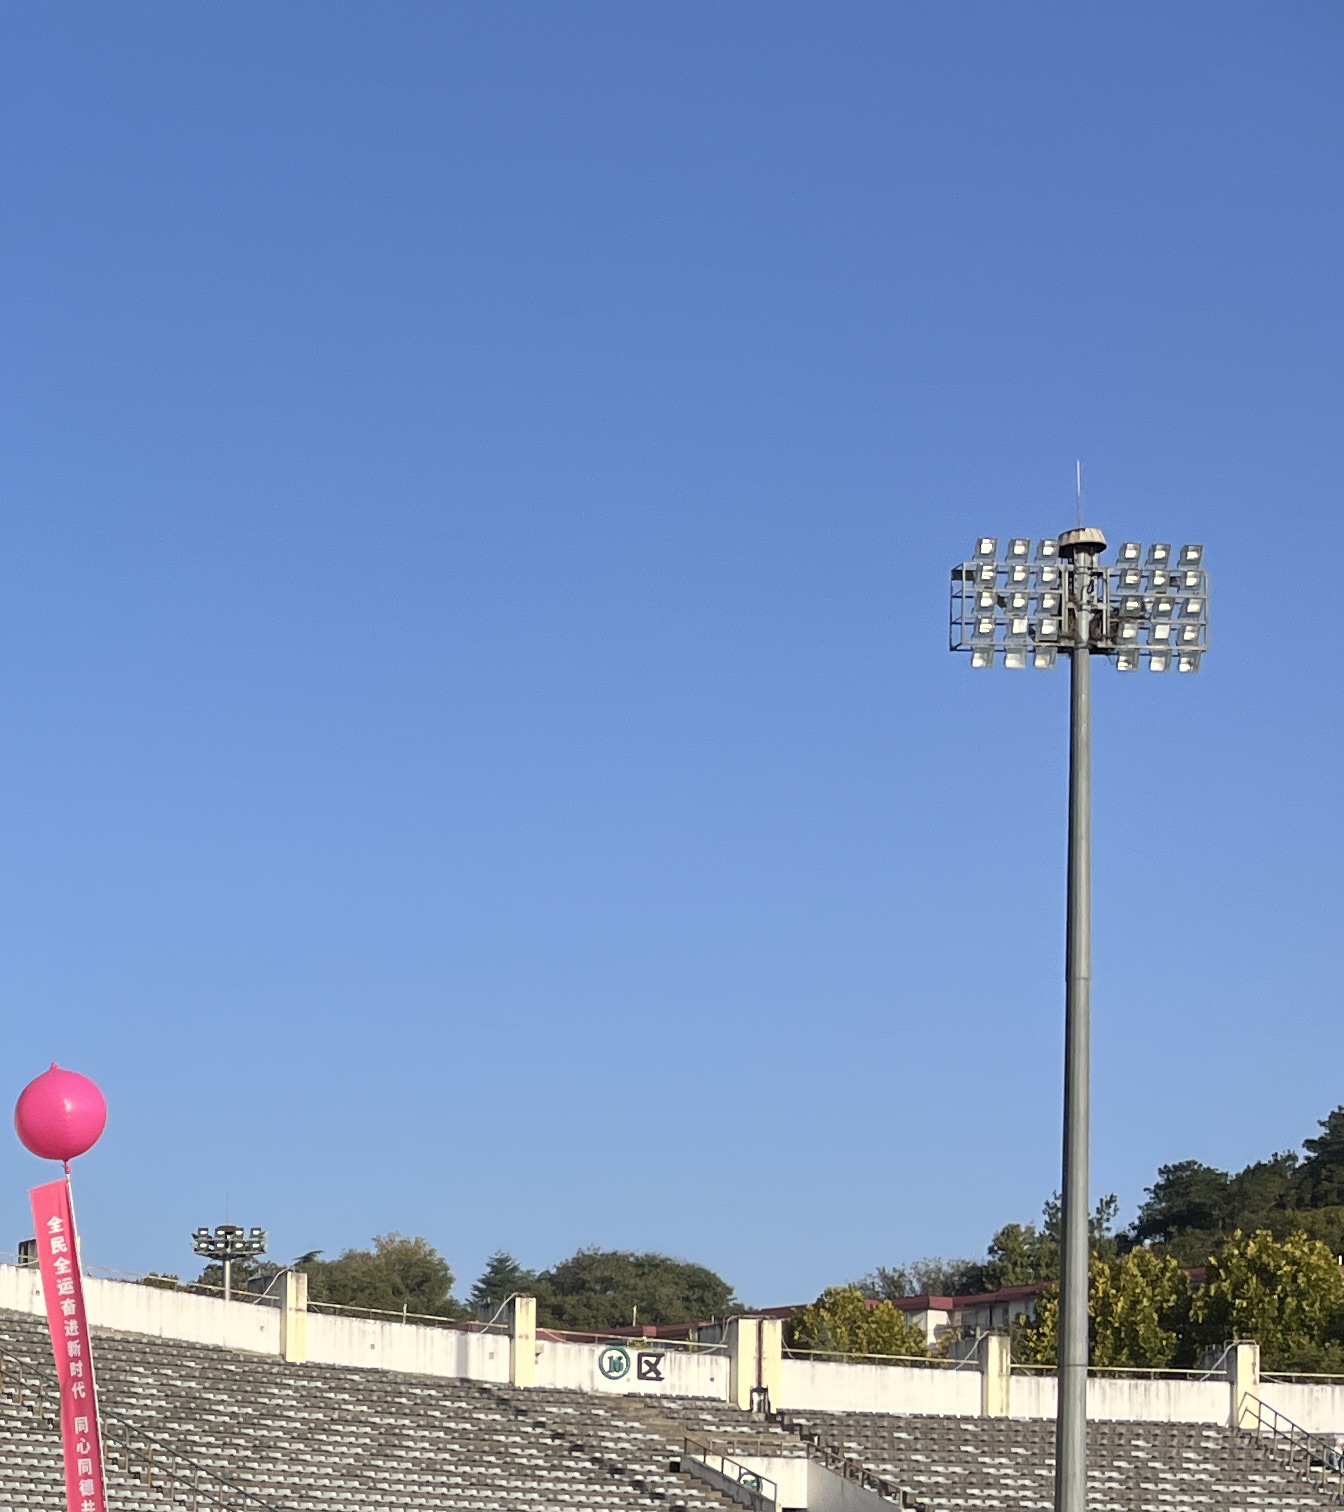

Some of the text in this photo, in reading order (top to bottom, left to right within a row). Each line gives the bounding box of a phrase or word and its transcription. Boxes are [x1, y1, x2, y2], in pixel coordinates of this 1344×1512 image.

[47, 1215, 86, 1400] 全民全运奋进新时代
[636, 1351, 666, 1381] 区
